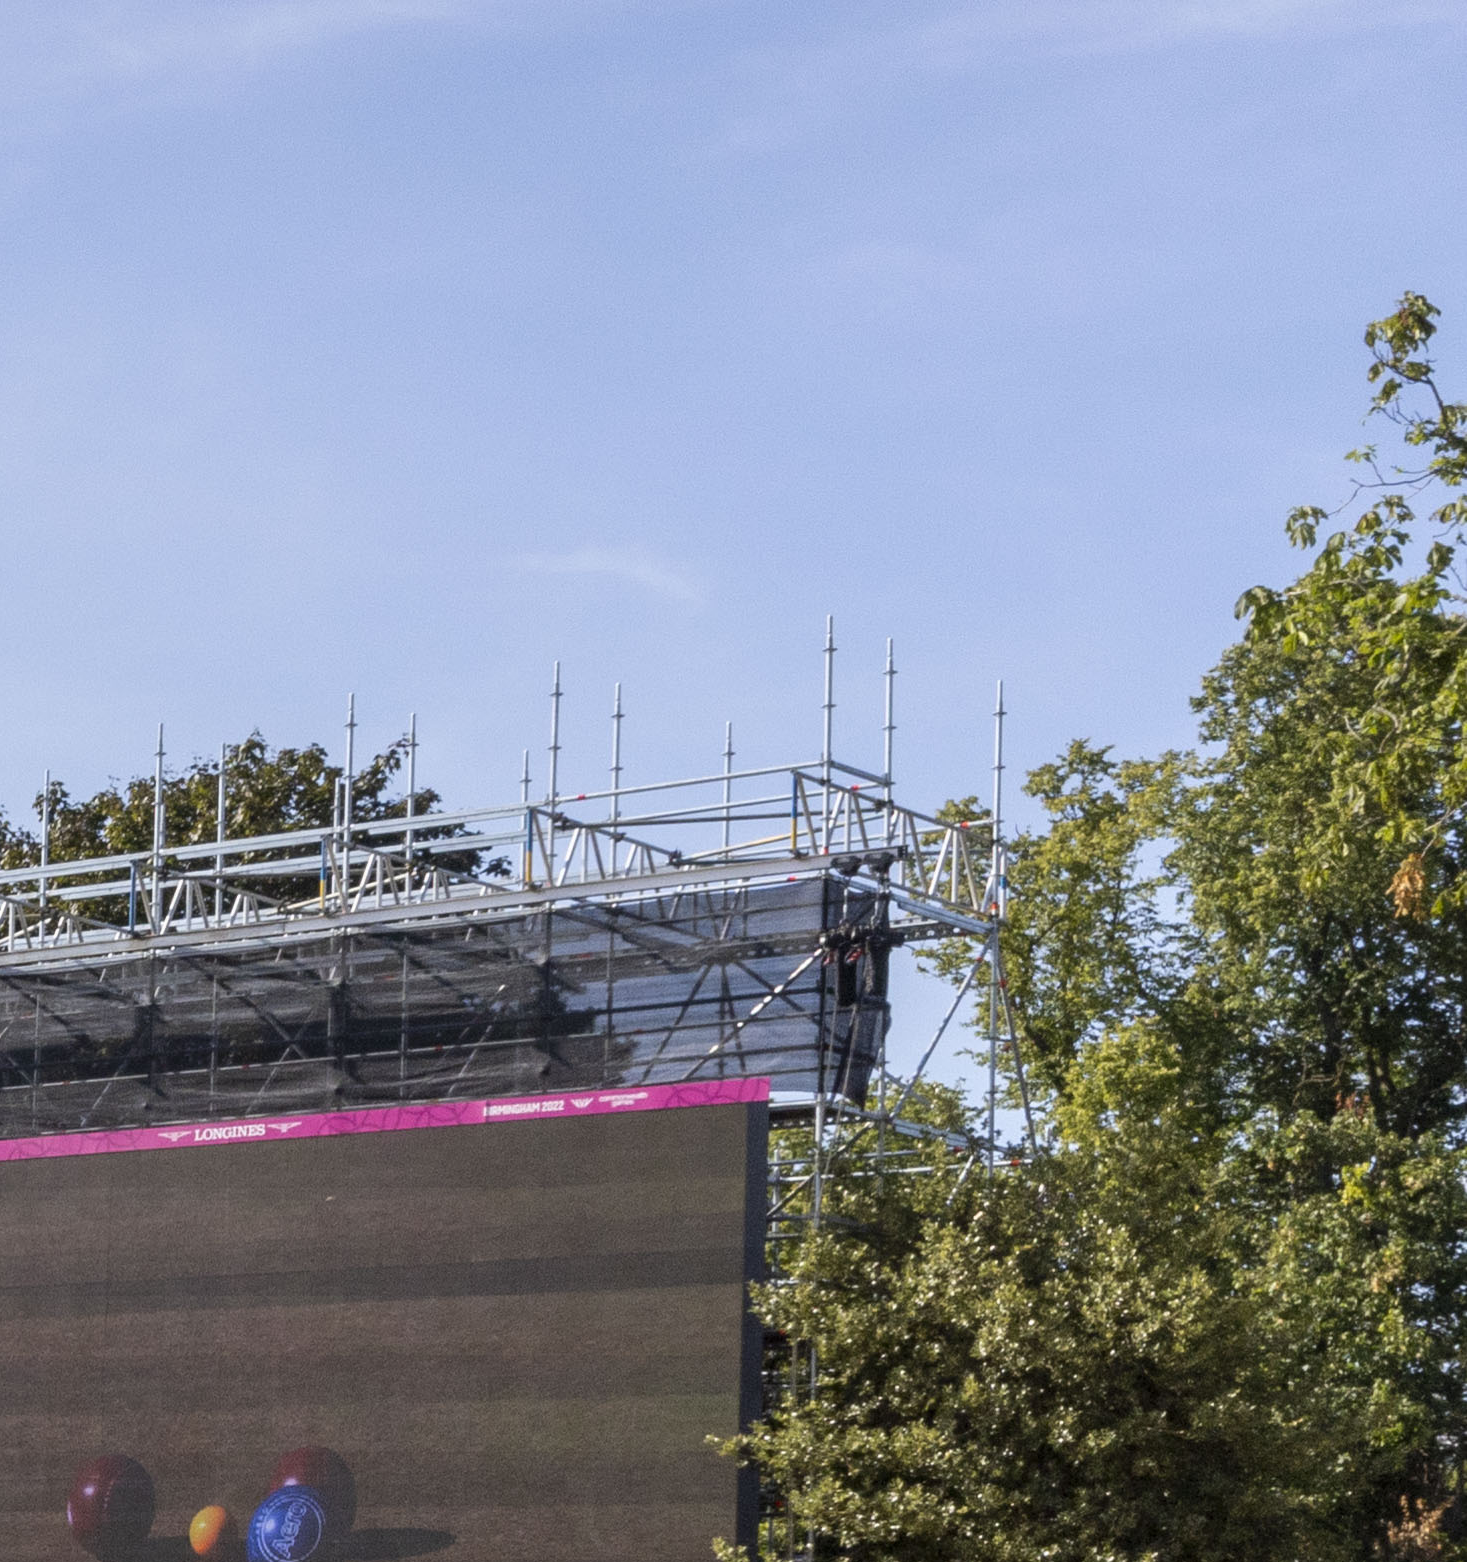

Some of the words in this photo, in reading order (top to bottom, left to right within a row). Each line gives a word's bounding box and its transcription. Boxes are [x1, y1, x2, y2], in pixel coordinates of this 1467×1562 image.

[542, 1100, 564, 1111] 2022
[194, 1124, 266, 1141] LONGINES
[272, 1502, 307, 1559] Aero
